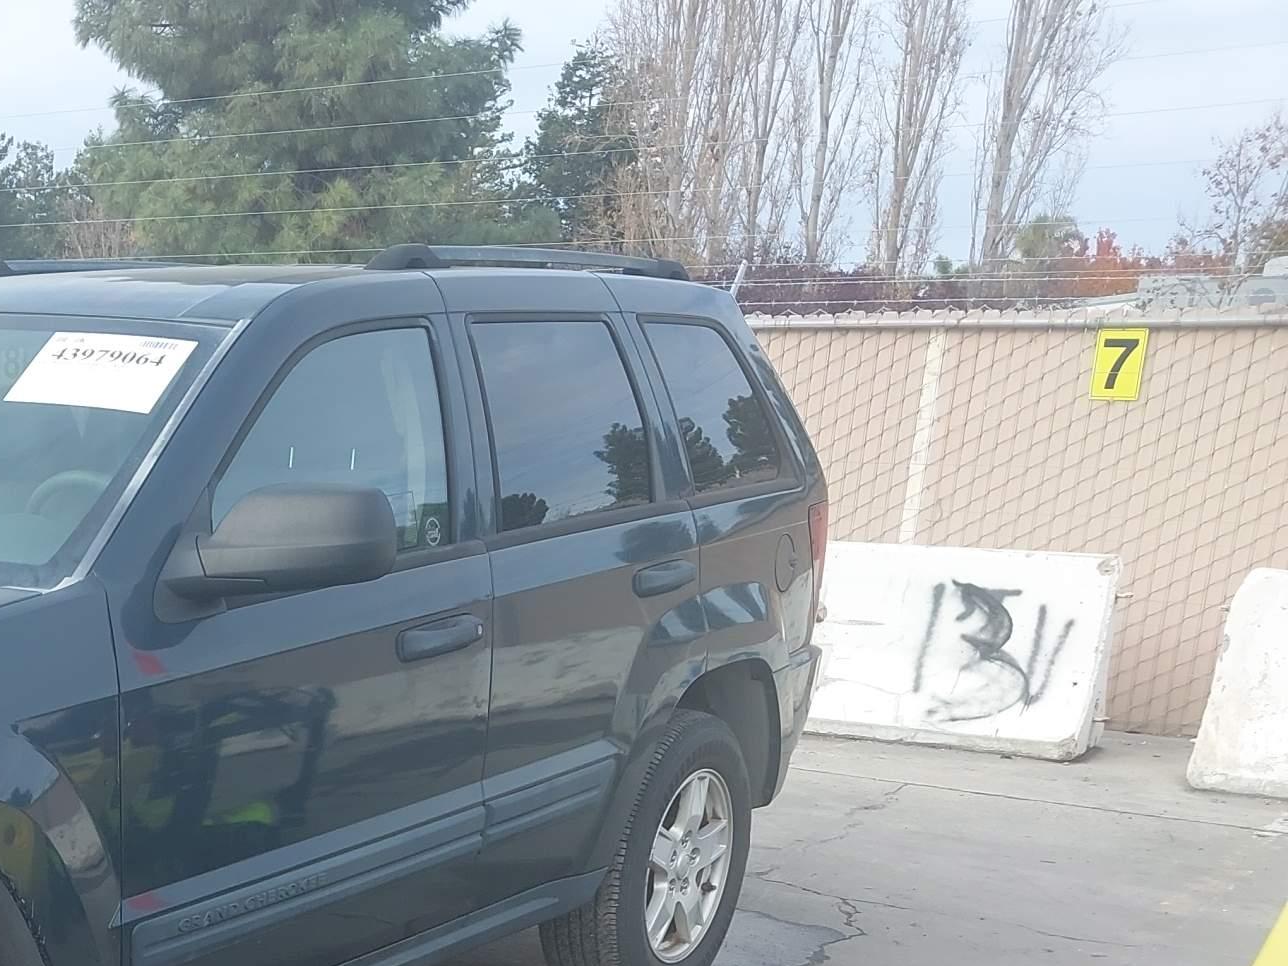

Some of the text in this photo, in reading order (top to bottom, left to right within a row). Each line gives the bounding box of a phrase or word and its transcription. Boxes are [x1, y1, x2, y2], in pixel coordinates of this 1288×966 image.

[51, 347, 167, 367] 43979064
[1104, 338, 1140, 390] 7
[177, 873, 328, 933] GRAND CHEROKEE
